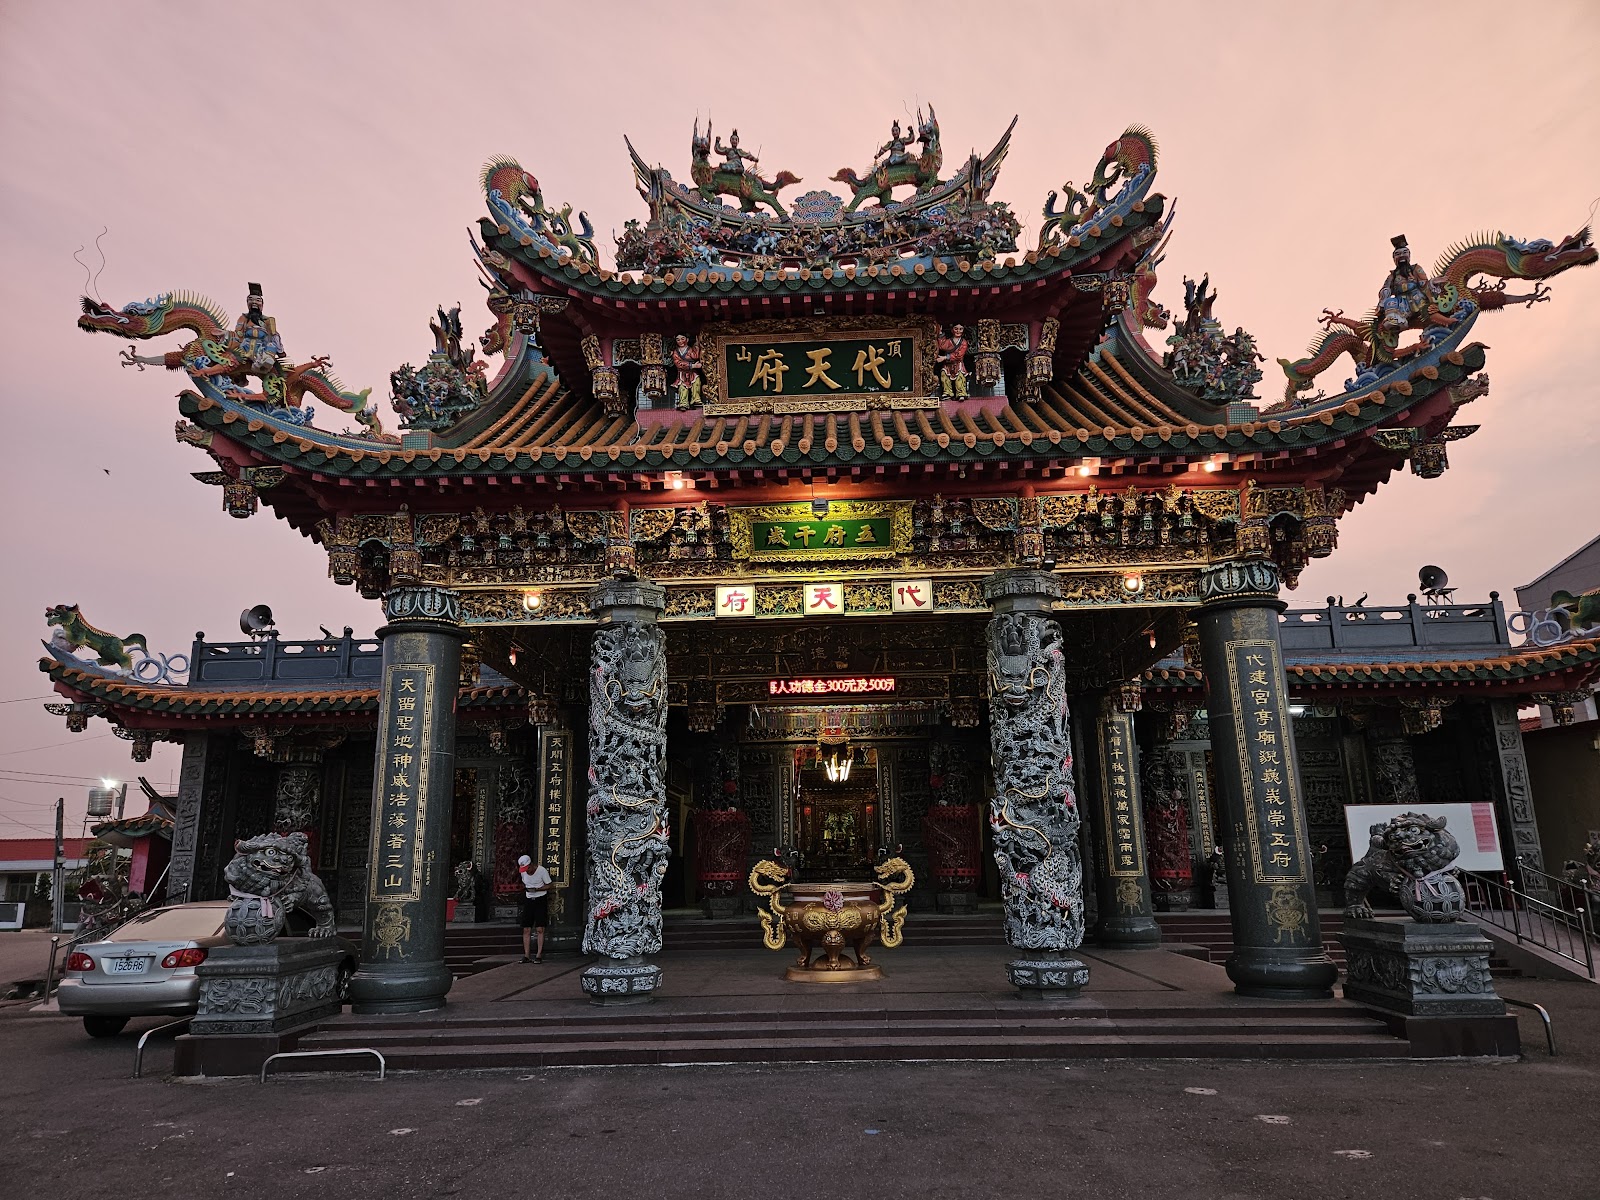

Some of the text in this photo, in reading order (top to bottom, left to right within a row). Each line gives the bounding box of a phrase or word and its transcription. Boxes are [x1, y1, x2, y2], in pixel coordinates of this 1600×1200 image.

[736, 346, 751, 362] 山
[887, 340, 902, 358] 頂
[749, 345, 892, 393] 代天府
[768, 524, 876, 547] 五府千歲
[722, 590, 749, 613] 府
[810, 588, 838, 609] 天
[898, 585, 926, 607] 代
